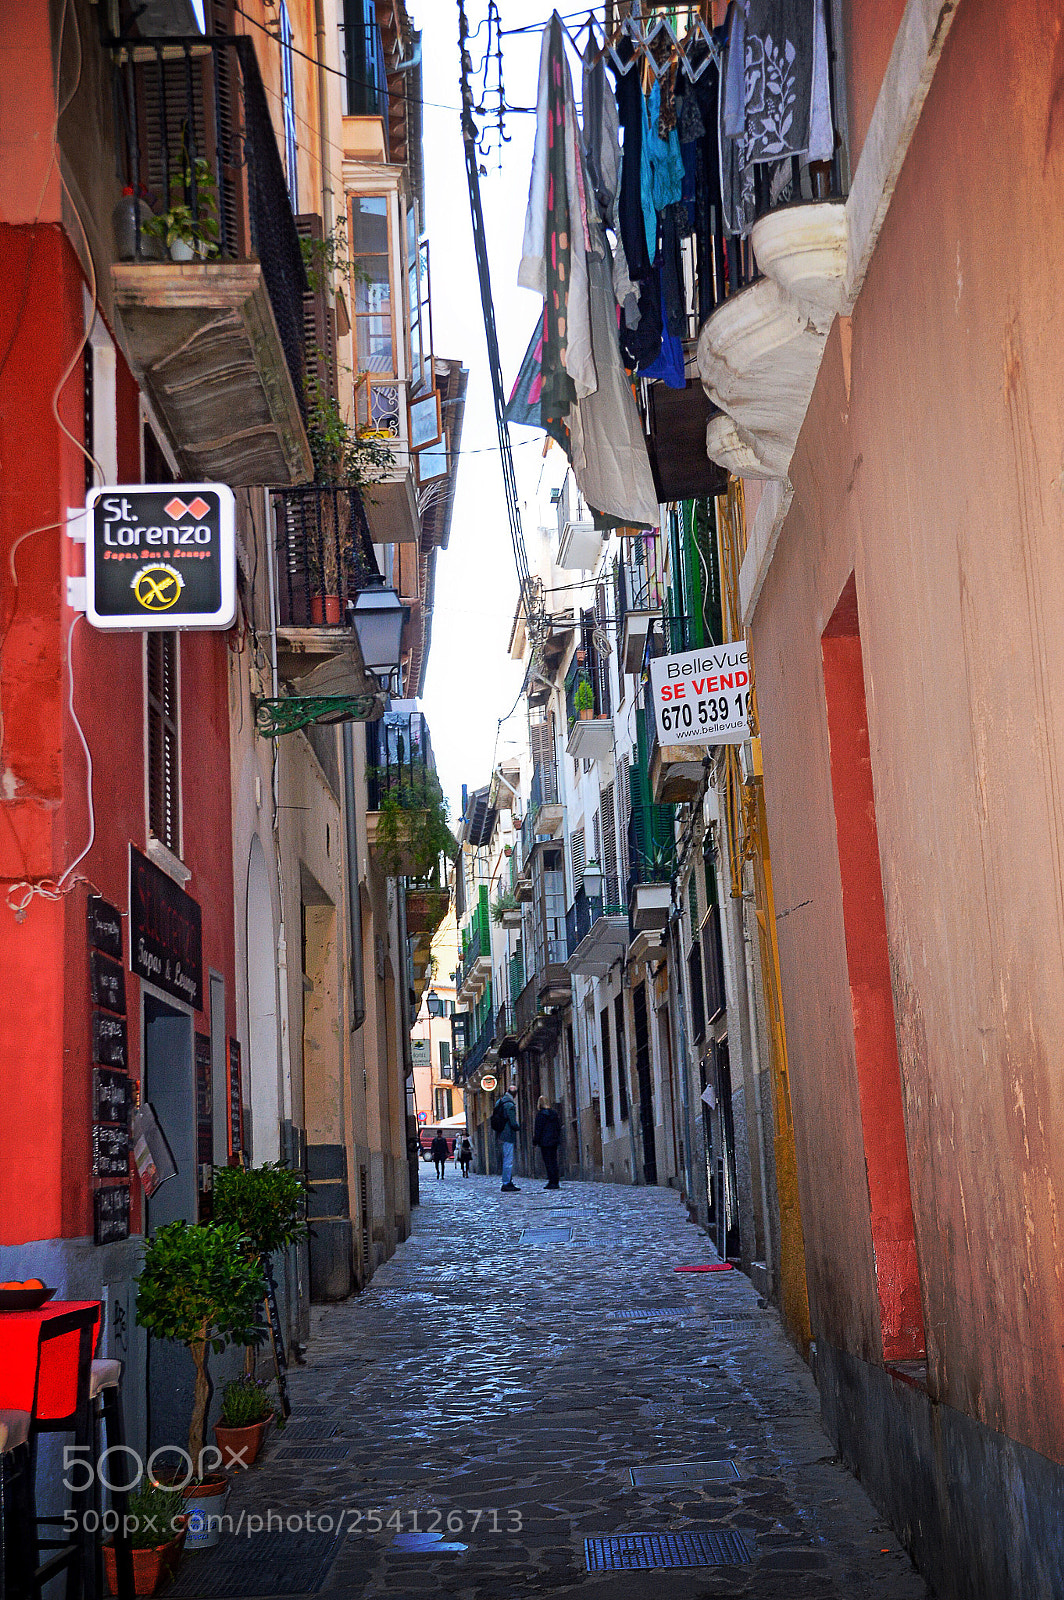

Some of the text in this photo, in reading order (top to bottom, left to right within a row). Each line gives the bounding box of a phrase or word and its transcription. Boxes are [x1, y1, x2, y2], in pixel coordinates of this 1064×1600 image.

[102, 498, 138, 522] St.
[103, 523, 211, 546] Lorenzo
[140, 549, 161, 559] Bar
[163, 550, 171, 558] &
[173, 549, 211, 560] Lounge
[667, 652, 750, 679] BelleVue
[660, 682, 686, 702] SE
[661, 703, 692, 731] 670
[698, 696, 729, 724] 539
